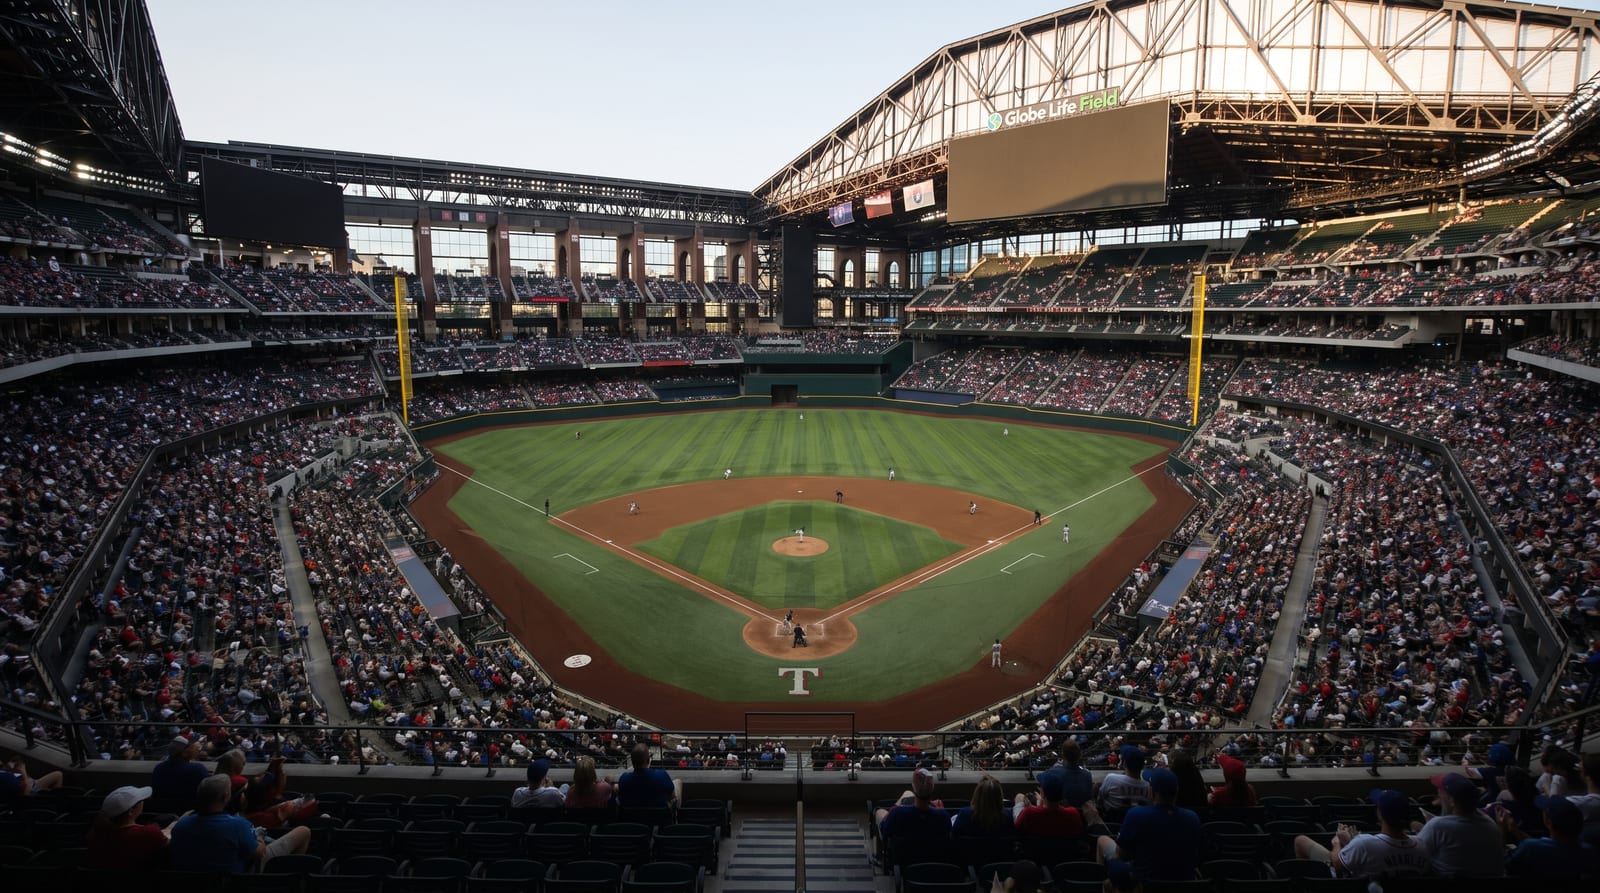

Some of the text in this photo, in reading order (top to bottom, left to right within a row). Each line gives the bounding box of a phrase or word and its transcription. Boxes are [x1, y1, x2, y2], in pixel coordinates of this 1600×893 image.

[1005, 89, 1118, 126] Globe Life Field
[778, 667, 822, 696] T
